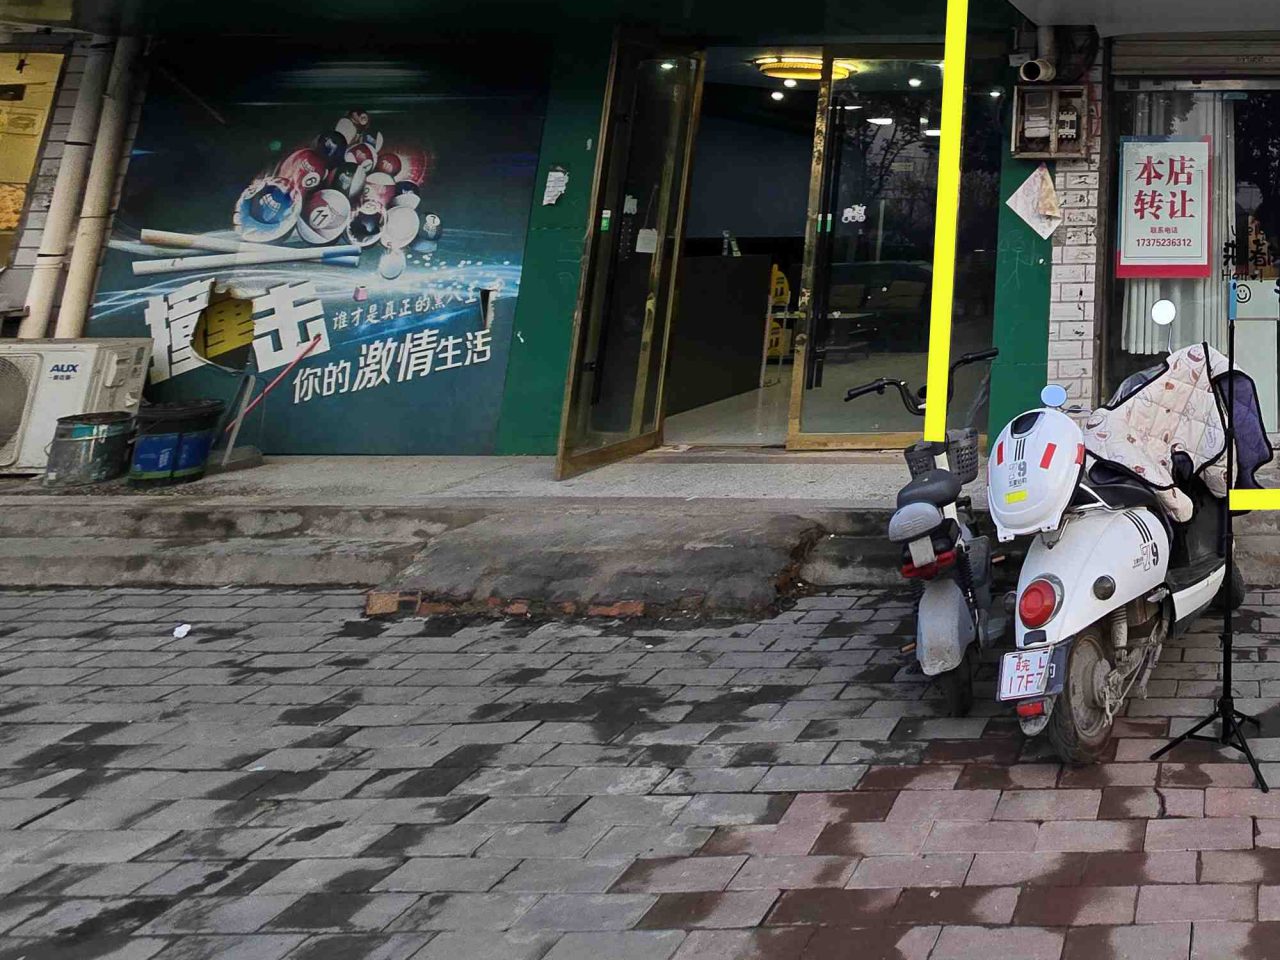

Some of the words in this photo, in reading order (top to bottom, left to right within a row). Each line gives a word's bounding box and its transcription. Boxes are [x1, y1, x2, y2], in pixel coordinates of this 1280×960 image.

[1135, 155, 1195, 186] 本店
[1134, 189, 1195, 220] 转让
[1136, 238, 1192, 247] 17375236312
[49, 363, 79, 373] AUX
[292, 329, 492, 405] 你的激情生活
[1016, 659, 1030, 672] 皖
